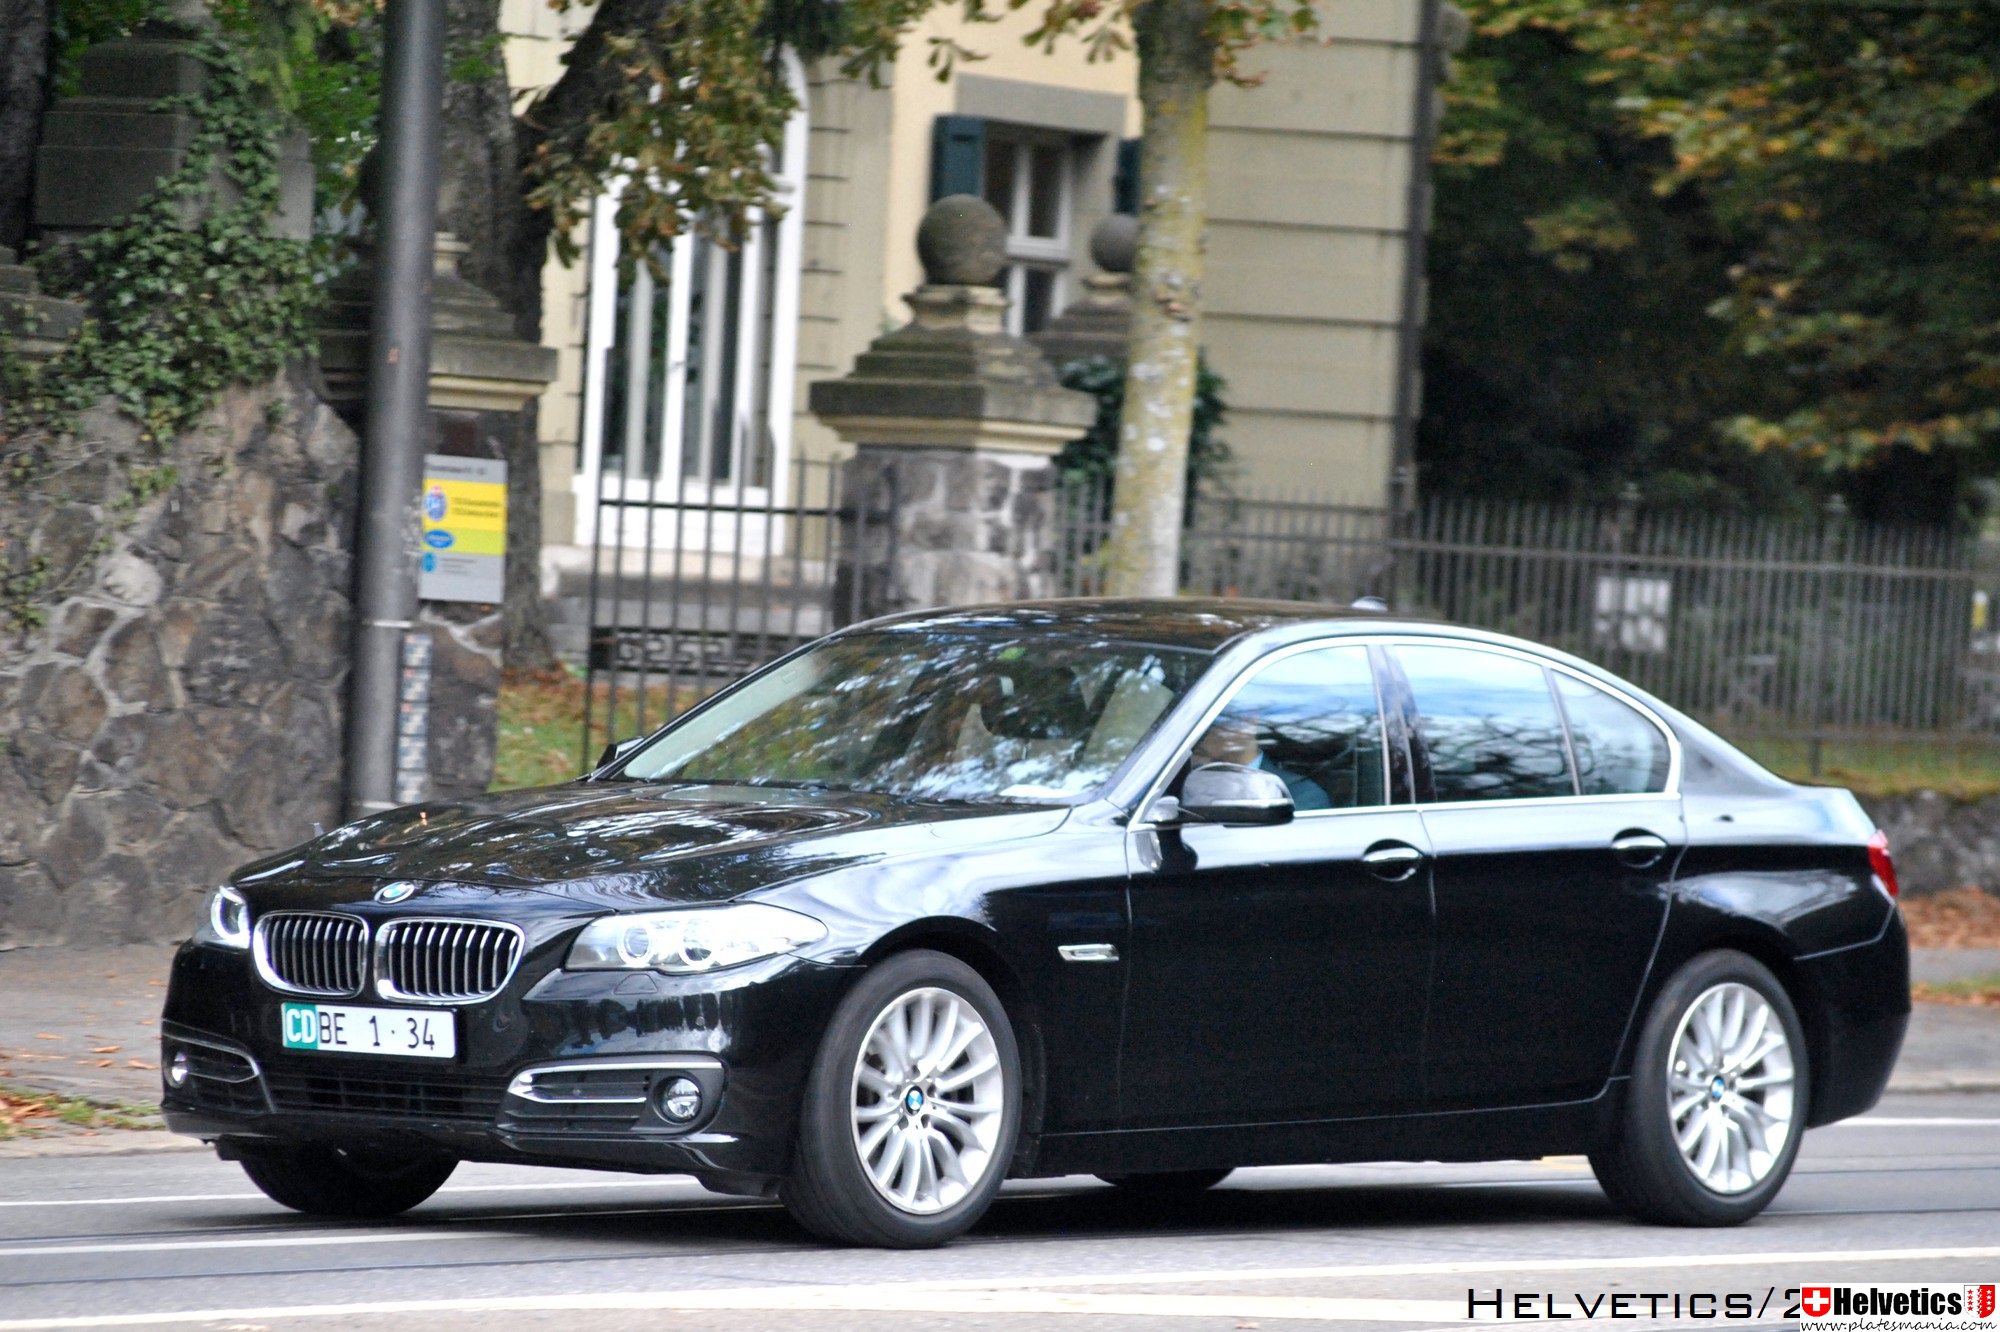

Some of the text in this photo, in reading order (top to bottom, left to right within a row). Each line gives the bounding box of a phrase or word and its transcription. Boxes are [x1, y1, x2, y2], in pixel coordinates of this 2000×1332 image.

[286, 1008, 317, 1044] CD
[319, 1011, 348, 1045] BE
[368, 1015, 381, 1047] 1
[406, 1017, 436, 1051] 34
